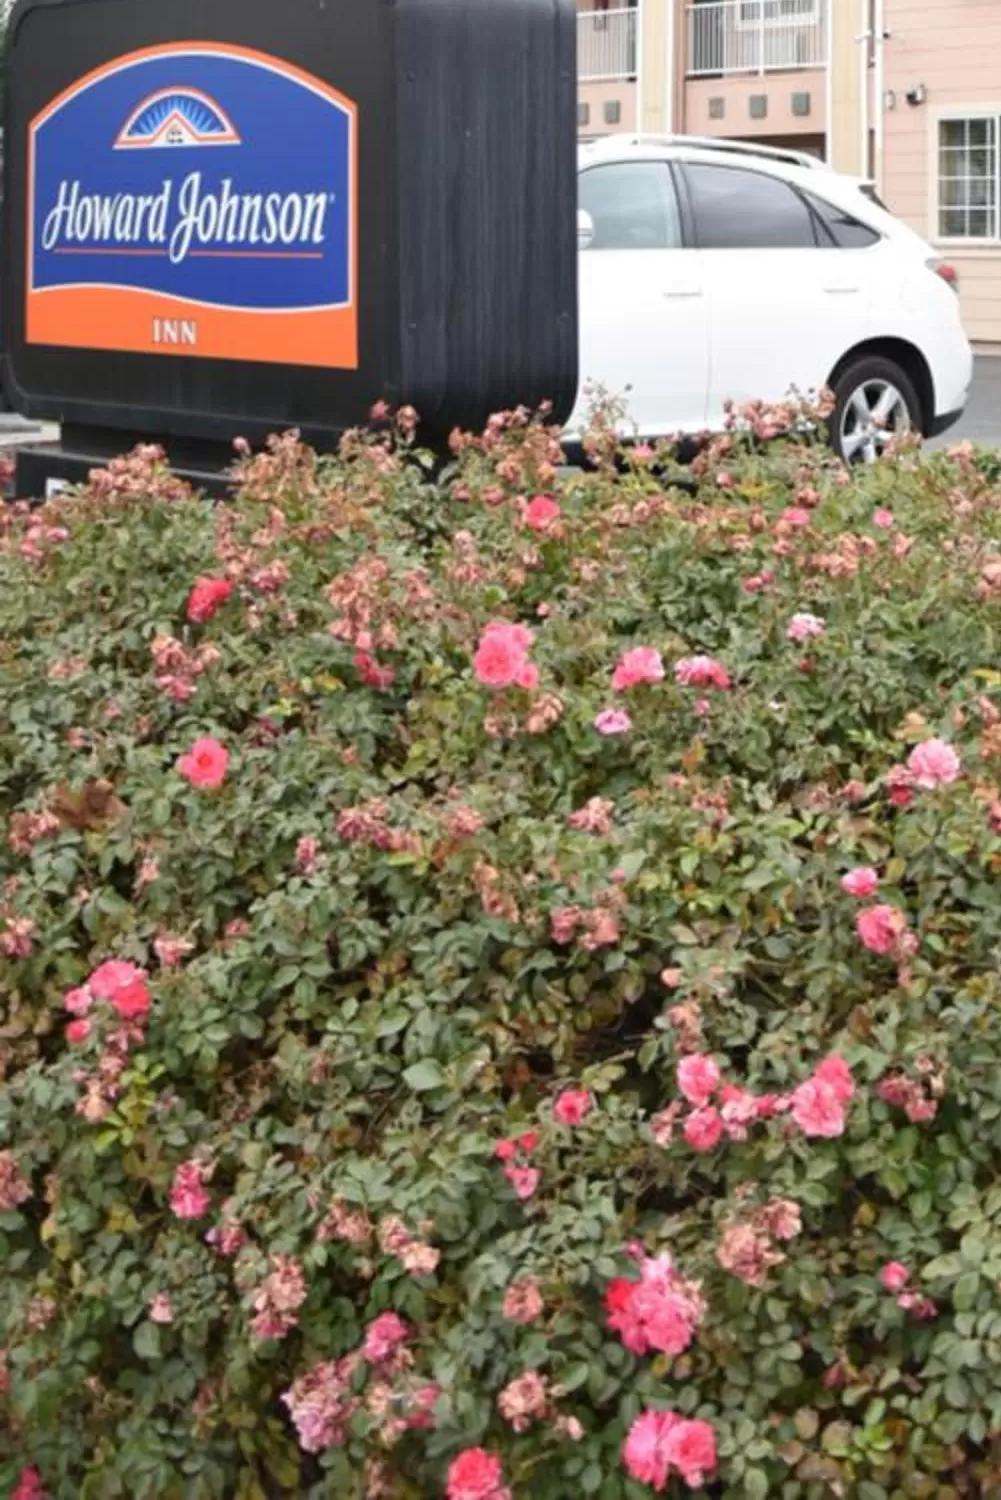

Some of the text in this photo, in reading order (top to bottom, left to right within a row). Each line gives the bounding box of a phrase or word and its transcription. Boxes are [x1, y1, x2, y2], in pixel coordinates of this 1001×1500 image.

[41, 171, 326, 264] Howard Johnson
[152, 318, 197, 345] INN
